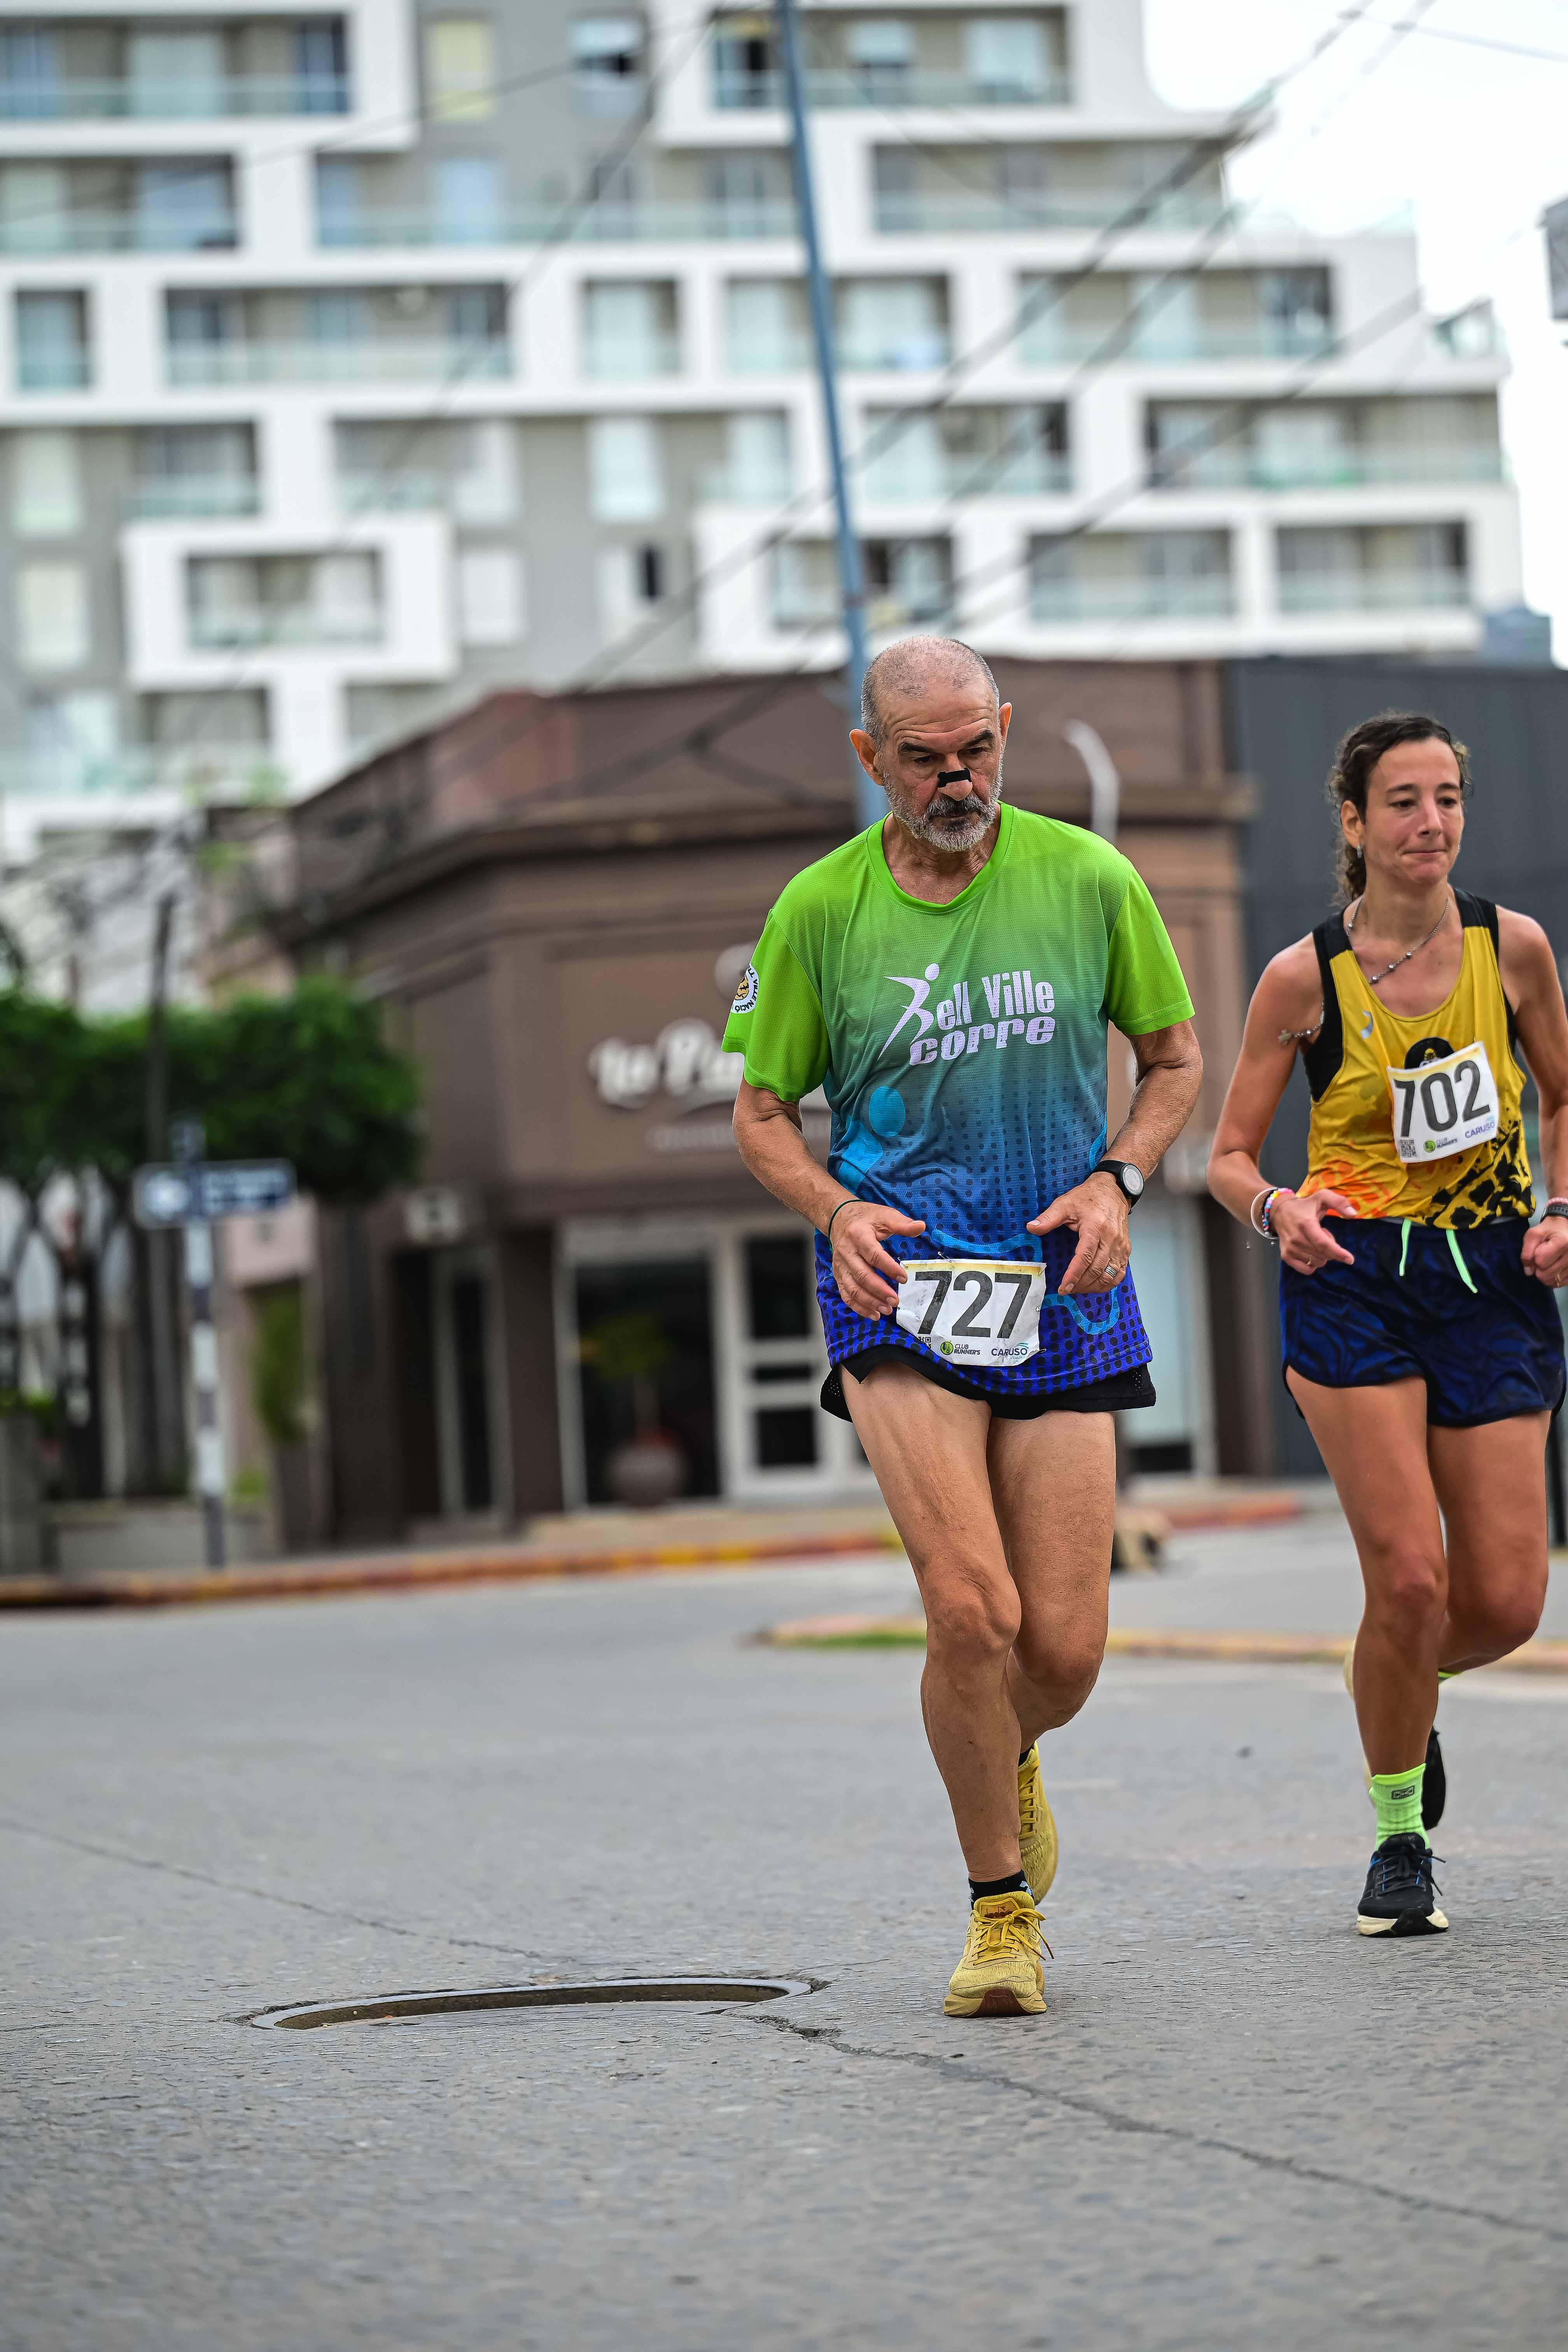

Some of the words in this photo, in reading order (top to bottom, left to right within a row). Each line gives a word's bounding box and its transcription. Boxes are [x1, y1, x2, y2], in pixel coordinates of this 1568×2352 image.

[981, 970, 1055, 1018] Ville
[909, 1016, 1055, 1066] corre
[1393, 1060, 1491, 1137] 702
[1465, 1121, 1495, 1139] CARUSO
[915, 1270, 1032, 1339] 727
[991, 1348, 1028, 1356] CARUSO
